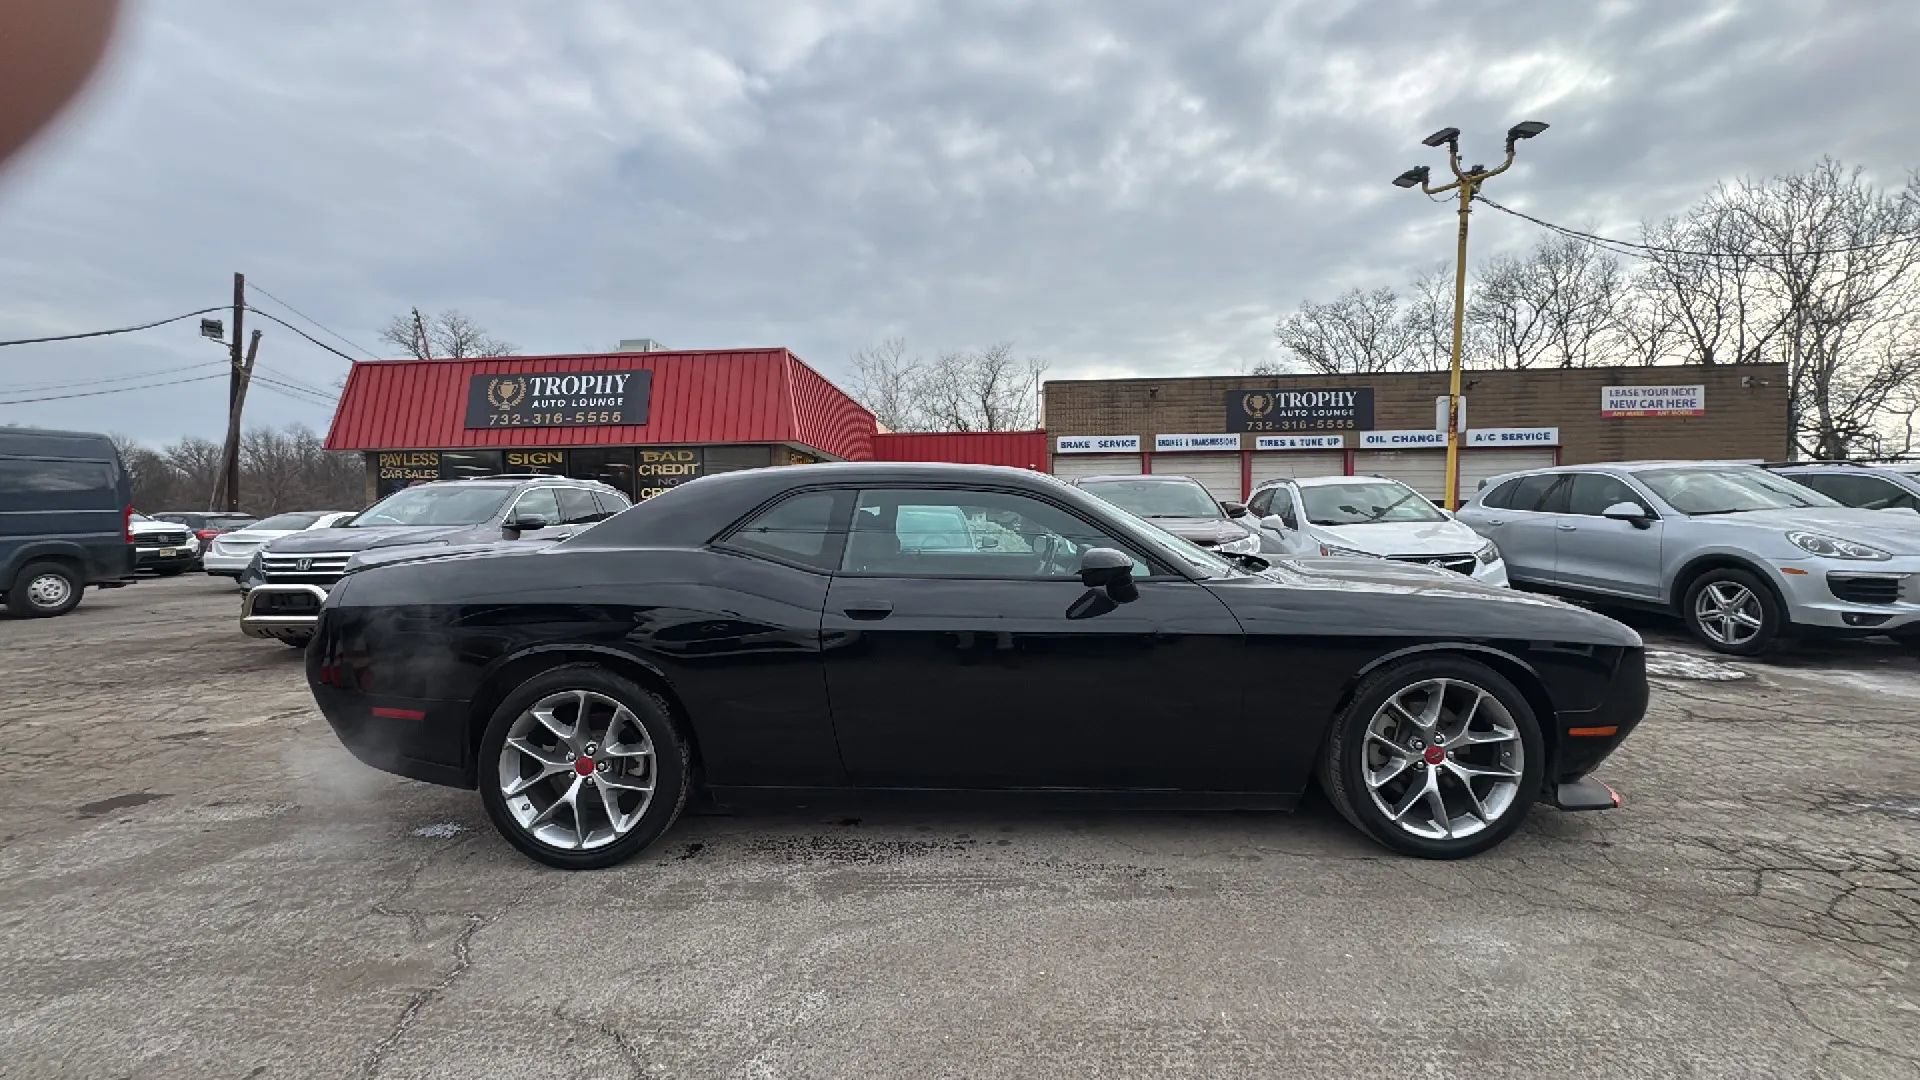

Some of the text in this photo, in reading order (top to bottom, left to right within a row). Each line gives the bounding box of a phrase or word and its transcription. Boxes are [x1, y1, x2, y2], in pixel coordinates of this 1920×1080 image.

[530, 374, 631, 397] TROPHY
[1609, 387, 1697, 397] LEASE YOUR NEXT
[531, 397, 624, 408] AUTO LOUNGE
[1275, 391, 1357, 408] TROPHY
[1609, 398, 1697, 409] NEW CAR HERE
[488, 411, 622, 426] 732-316-5555
[1280, 409, 1308, 417] AUTO
[1246, 419, 1355, 430] 732-316-5555
[1259, 439, 1286, 447] TIRES
[1300, 438, 1323, 446] TUNE
[1327, 437, 1340, 446] UP
[1366, 434, 1443, 443] OIL CHANGE
[1474, 431, 1551, 442] A/C SERVICE
[1060, 439, 1137, 449] BRAKE SERVICE
[379, 452, 439, 466] PAYLESS
[507, 452, 563, 465] SIGN
[640, 450, 694, 462] BAD
[380, 469, 439, 479] CAR SALES
[638, 463, 699, 476] CREDIT
[657, 478, 680, 486] NO
